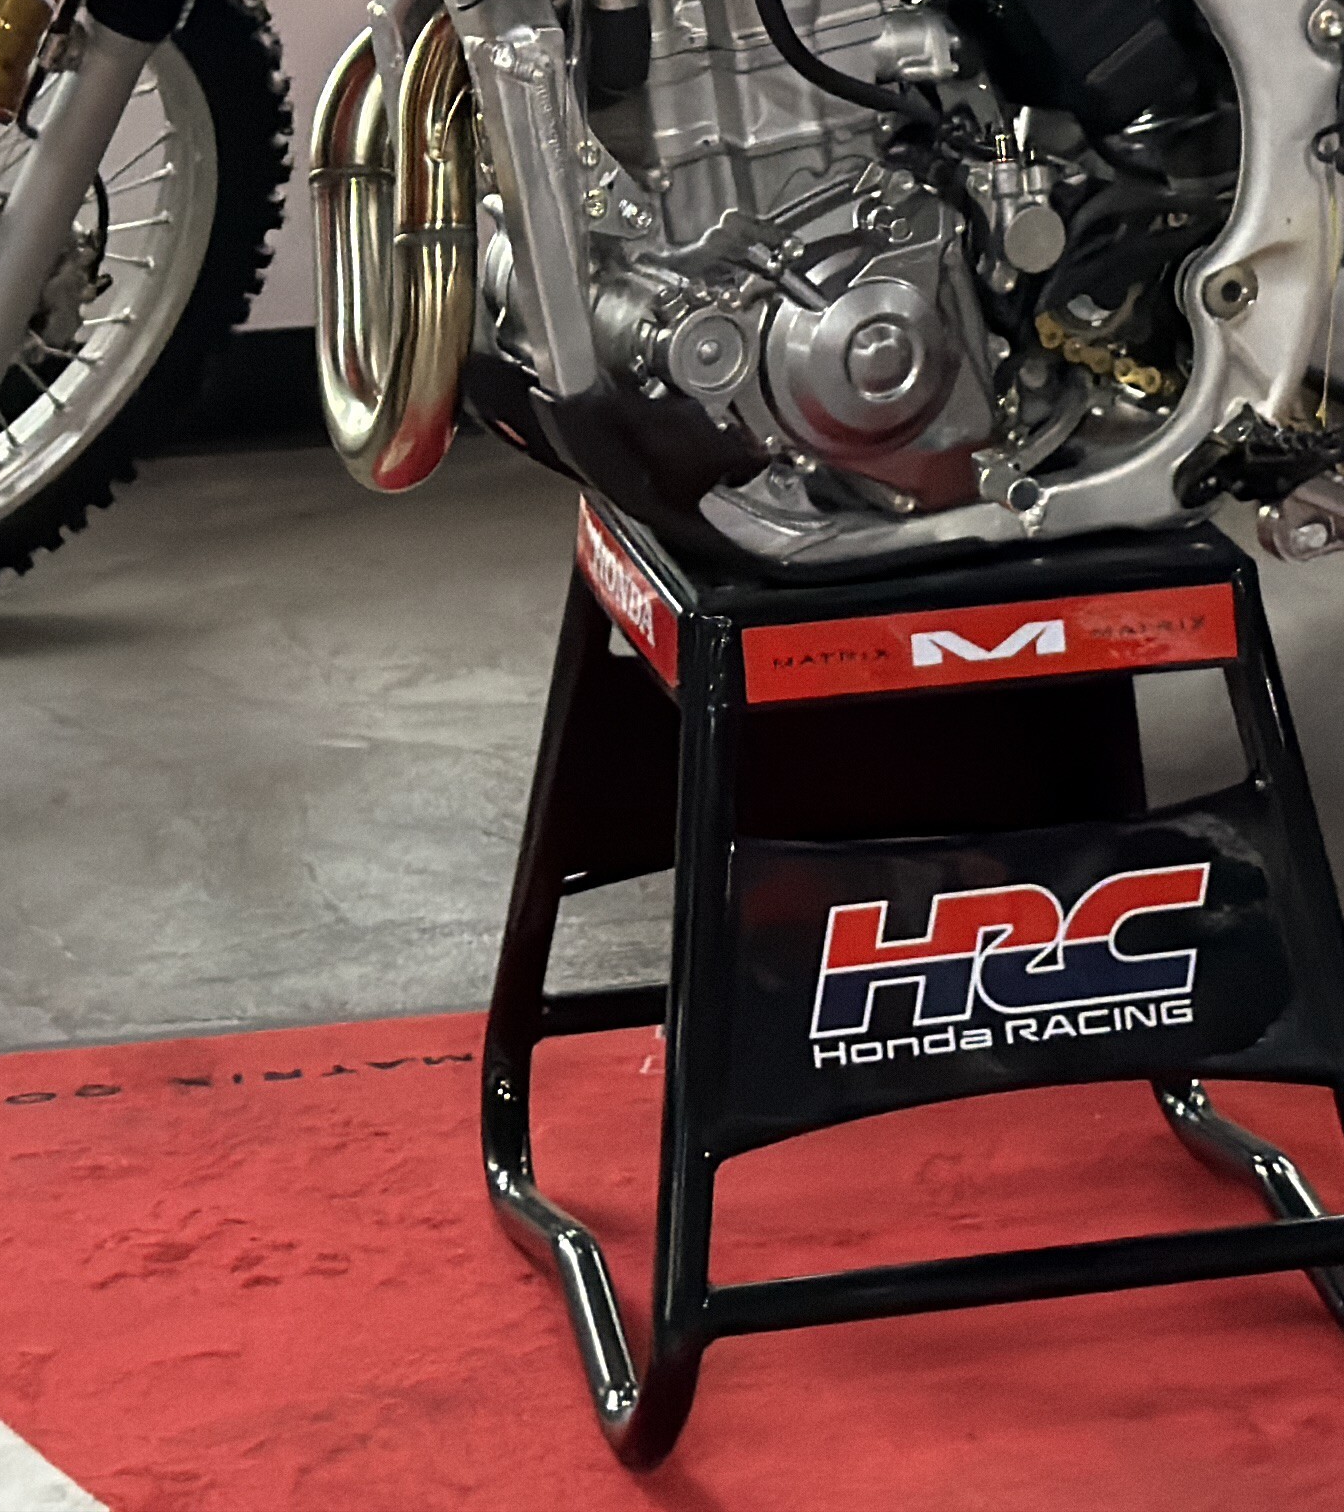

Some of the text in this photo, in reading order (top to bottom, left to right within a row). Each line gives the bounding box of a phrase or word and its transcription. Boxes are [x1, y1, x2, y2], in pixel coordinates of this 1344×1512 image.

[773, 648, 889, 671] MATRIX
[809, 862, 1211, 1040] HRC
[812, 999, 1194, 1069] Honda RACING
